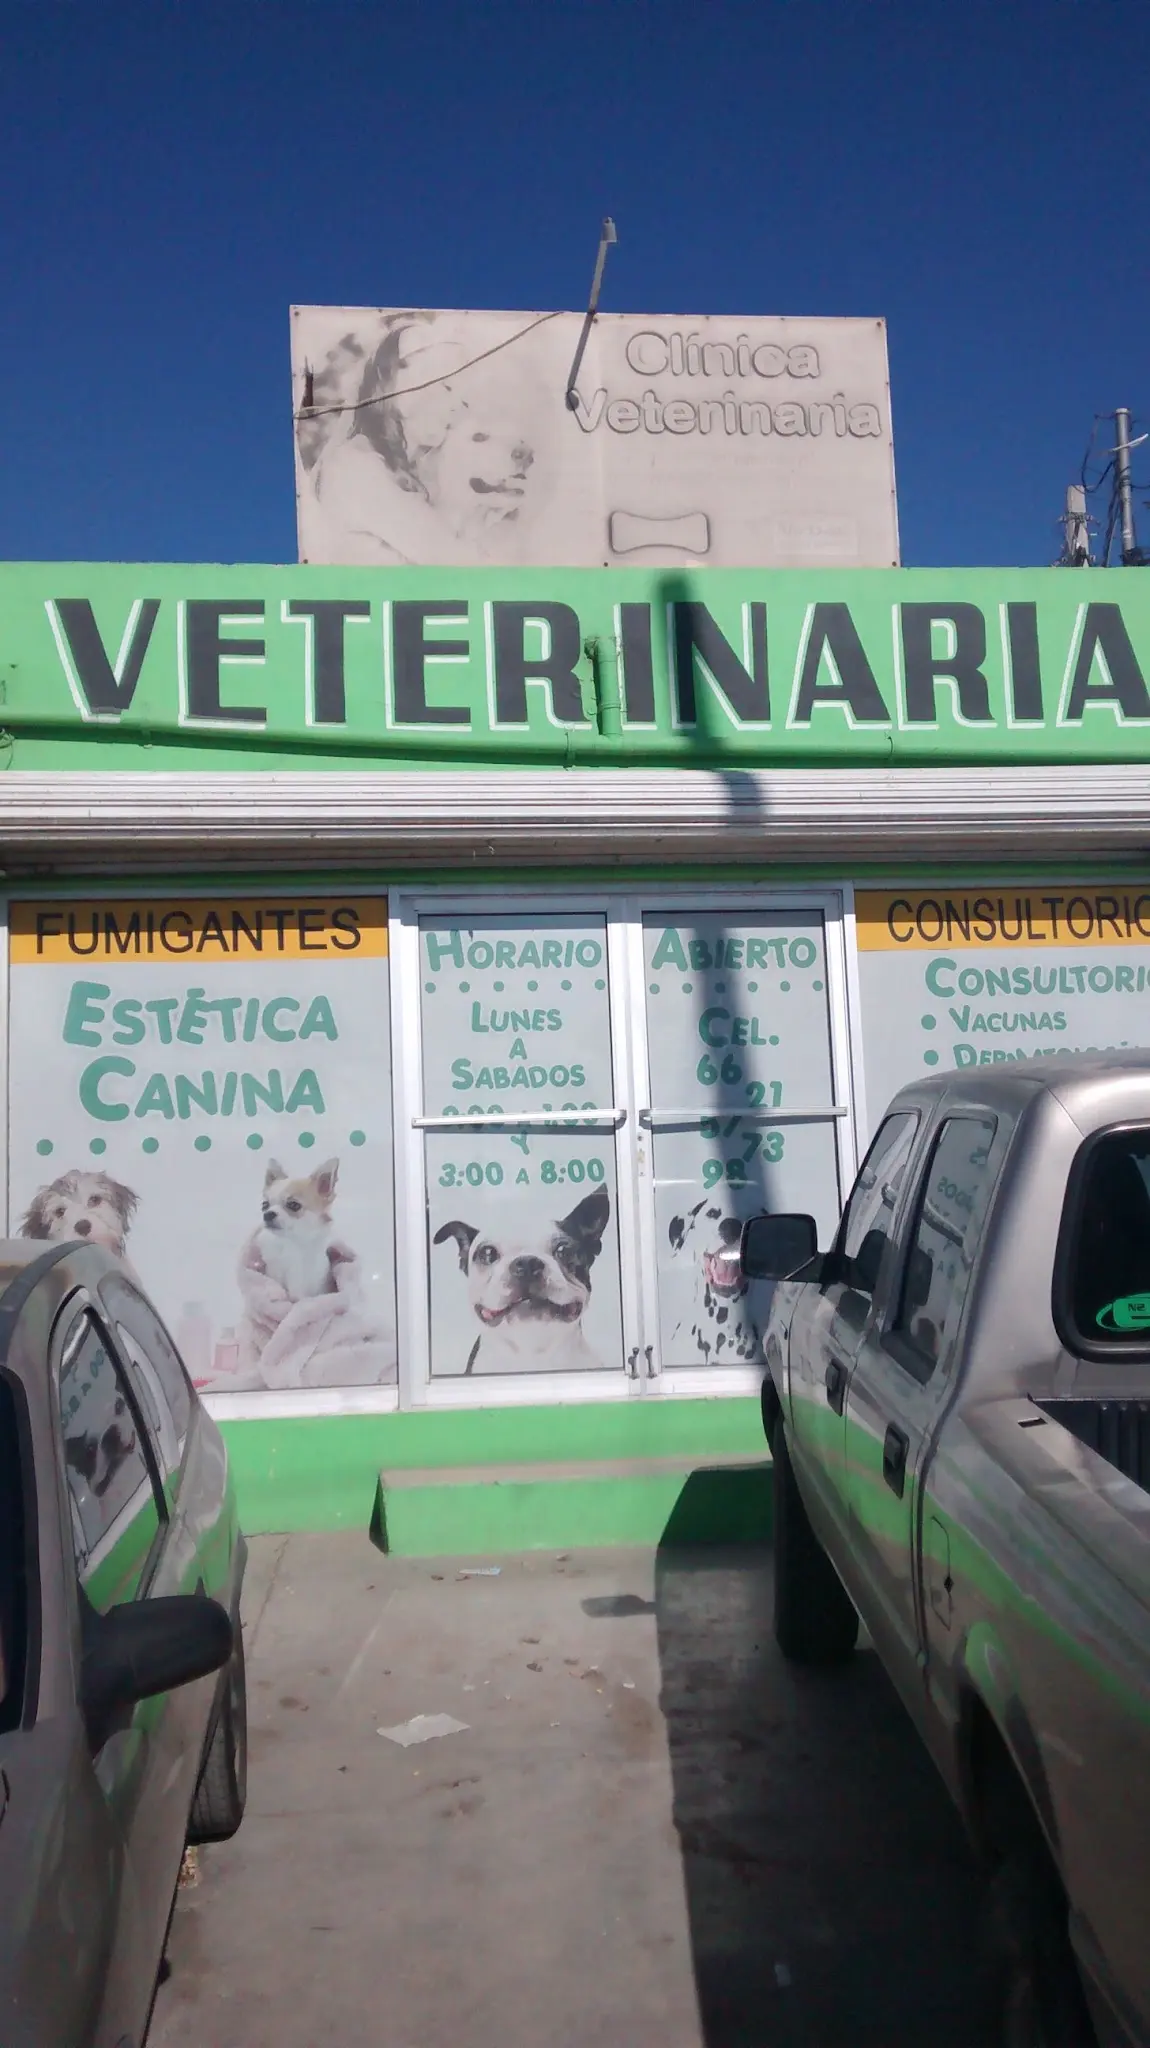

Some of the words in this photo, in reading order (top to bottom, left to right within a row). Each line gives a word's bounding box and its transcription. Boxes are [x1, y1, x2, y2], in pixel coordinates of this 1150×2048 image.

[626, 331, 820, 379] Clínica
[573, 388, 881, 438] Veterinaria
[45, 598, 1150, 731] VETERINARIA
[36, 908, 361, 955] FUMIGANTES
[651, 927, 817, 972] ABIERTO
[426, 929, 602, 971] HORARIO
[925, 957, 1150, 998] CONSULTORI
[471, 1001, 562, 1033] LUNES
[698, 1007, 780, 1048] CEL.
[948, 1005, 1067, 1032] VACUNAS
[509, 1038, 528, 1060] A
[451, 1058, 586, 1090] SABADOS
[696, 1054, 743, 1086] 66
[79, 1055, 326, 1122] CANINA
[745, 1081, 783, 1107] 21
[510, 1130, 530, 1155] Y
[742, 1131, 785, 1163] 73
[438, 1160, 504, 1187] 3:00
[515, 1167, 530, 1185] A
[540, 1158, 605, 1184] 8:00
